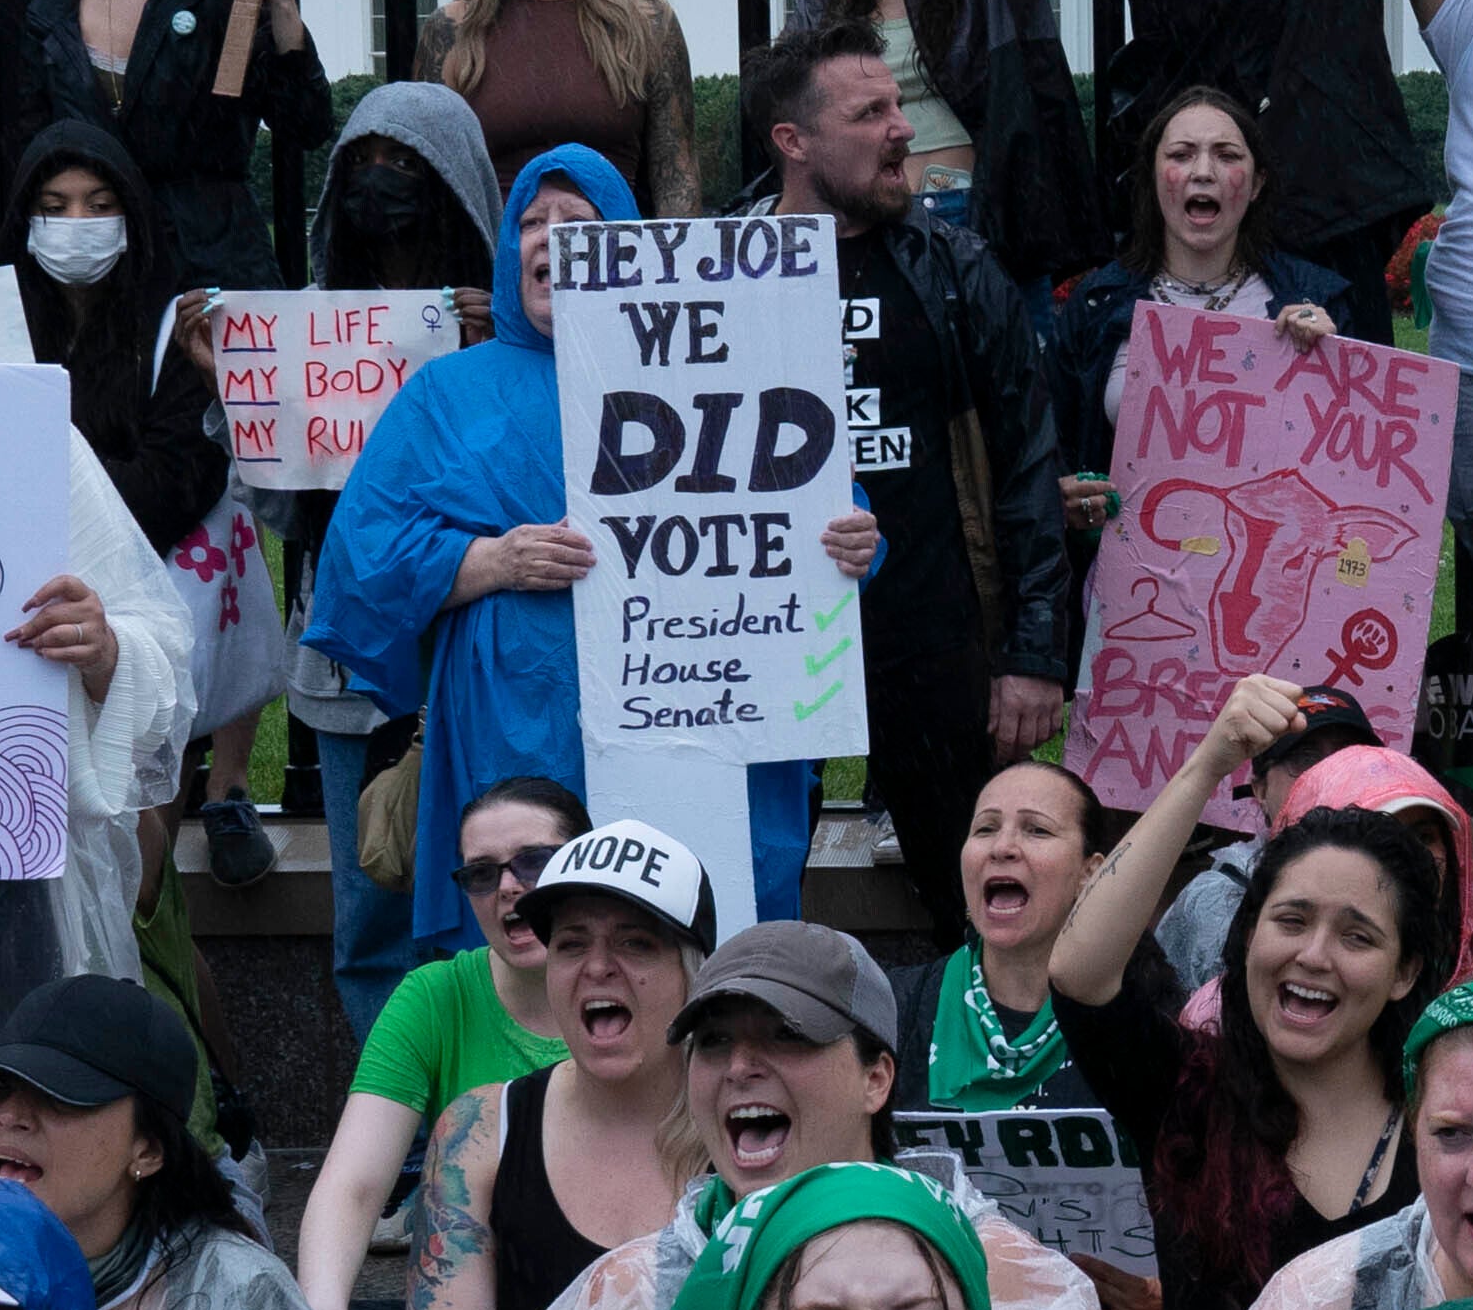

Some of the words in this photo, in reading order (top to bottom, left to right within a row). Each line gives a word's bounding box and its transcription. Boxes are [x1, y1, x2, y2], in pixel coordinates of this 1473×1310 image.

[553, 222, 691, 291] HEY
[697, 217, 819, 283] JOE
[223, 312, 277, 348] MY
[620, 301, 729, 367] WE
[225, 366, 277, 400] MY
[1146, 310, 1240, 387] WE
[1275, 335, 1428, 420] ARE
[235, 418, 275, 454] MY
[589, 387, 835, 494] DID
[1137, 387, 1266, 467] NOT
[1300, 394, 1434, 504] YOUR
[600, 512, 792, 580] VOTE
[1337, 557, 1367, 577] 1973
[622, 592, 805, 642] President
[622, 653, 751, 686] House
[619, 688, 764, 730] Senate
[561, 835, 670, 888] NOPE
